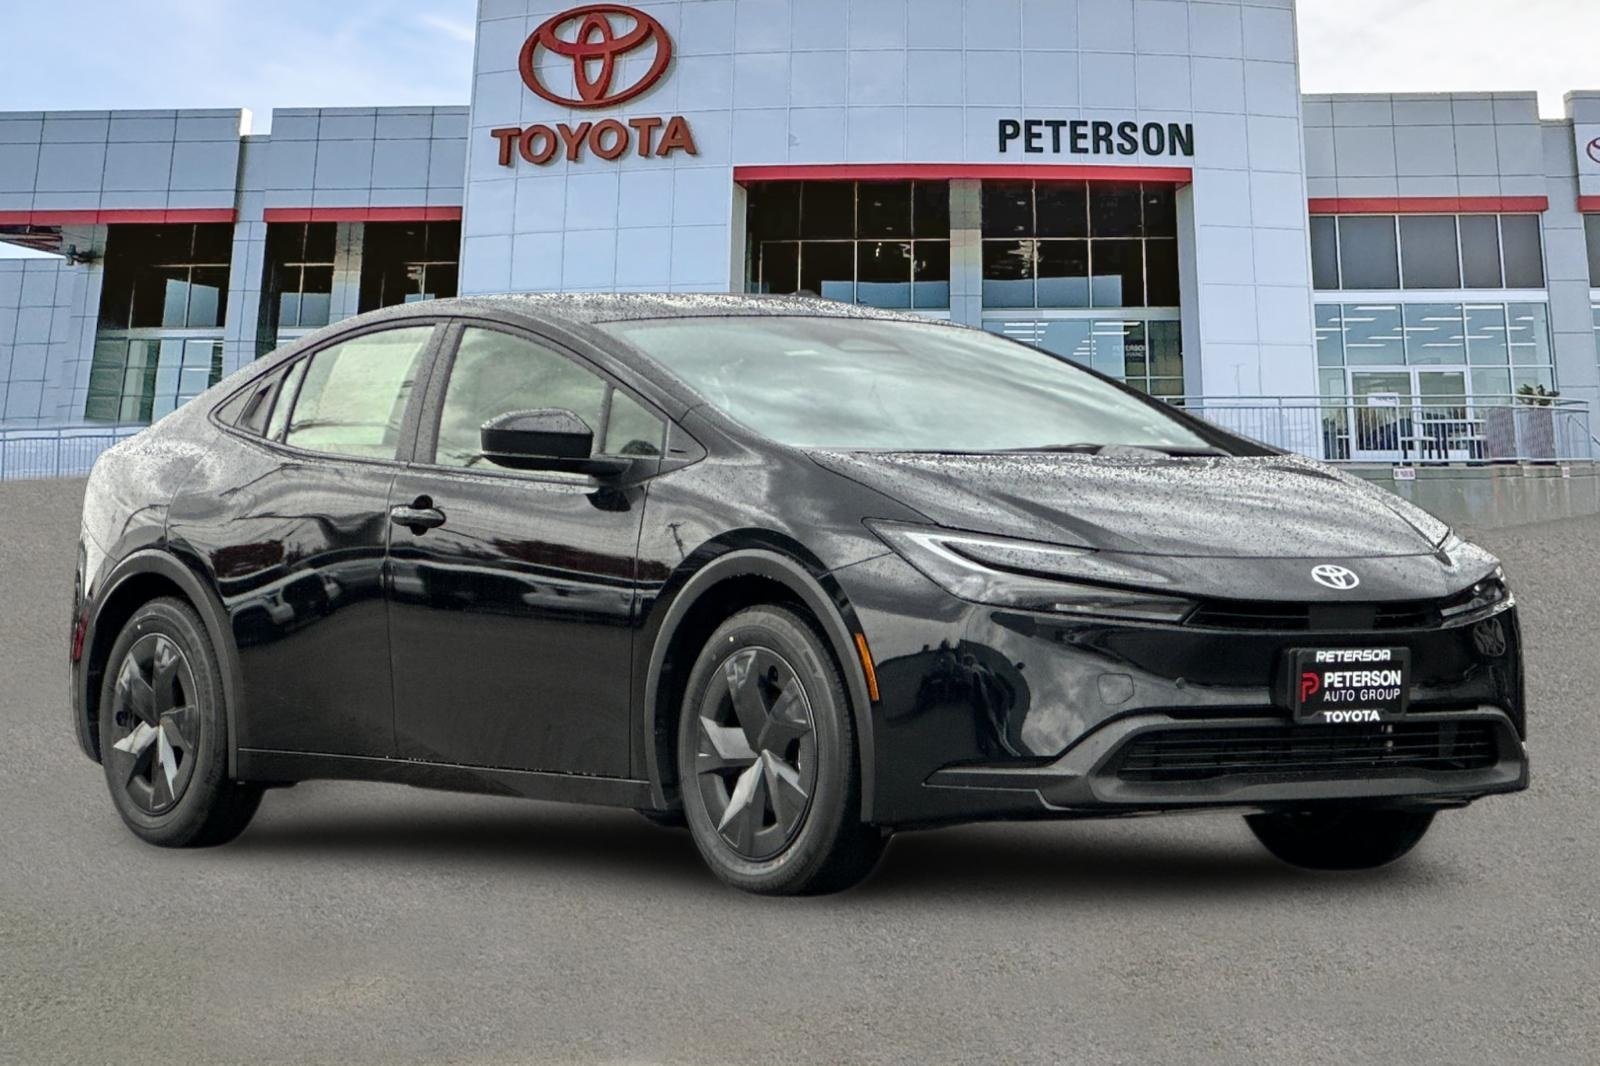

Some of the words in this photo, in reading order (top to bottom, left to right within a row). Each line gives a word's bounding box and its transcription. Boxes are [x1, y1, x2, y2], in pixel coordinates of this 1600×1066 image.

[491, 115, 697, 166] TOYOTA
[998, 119, 1195, 156] PETERSON
[1324, 670, 1402, 688] PETERSON
[1323, 690, 1355, 702] AUTO
[1360, 688, 1401, 701] GROUP
[1324, 710, 1381, 723] TOYOTA
